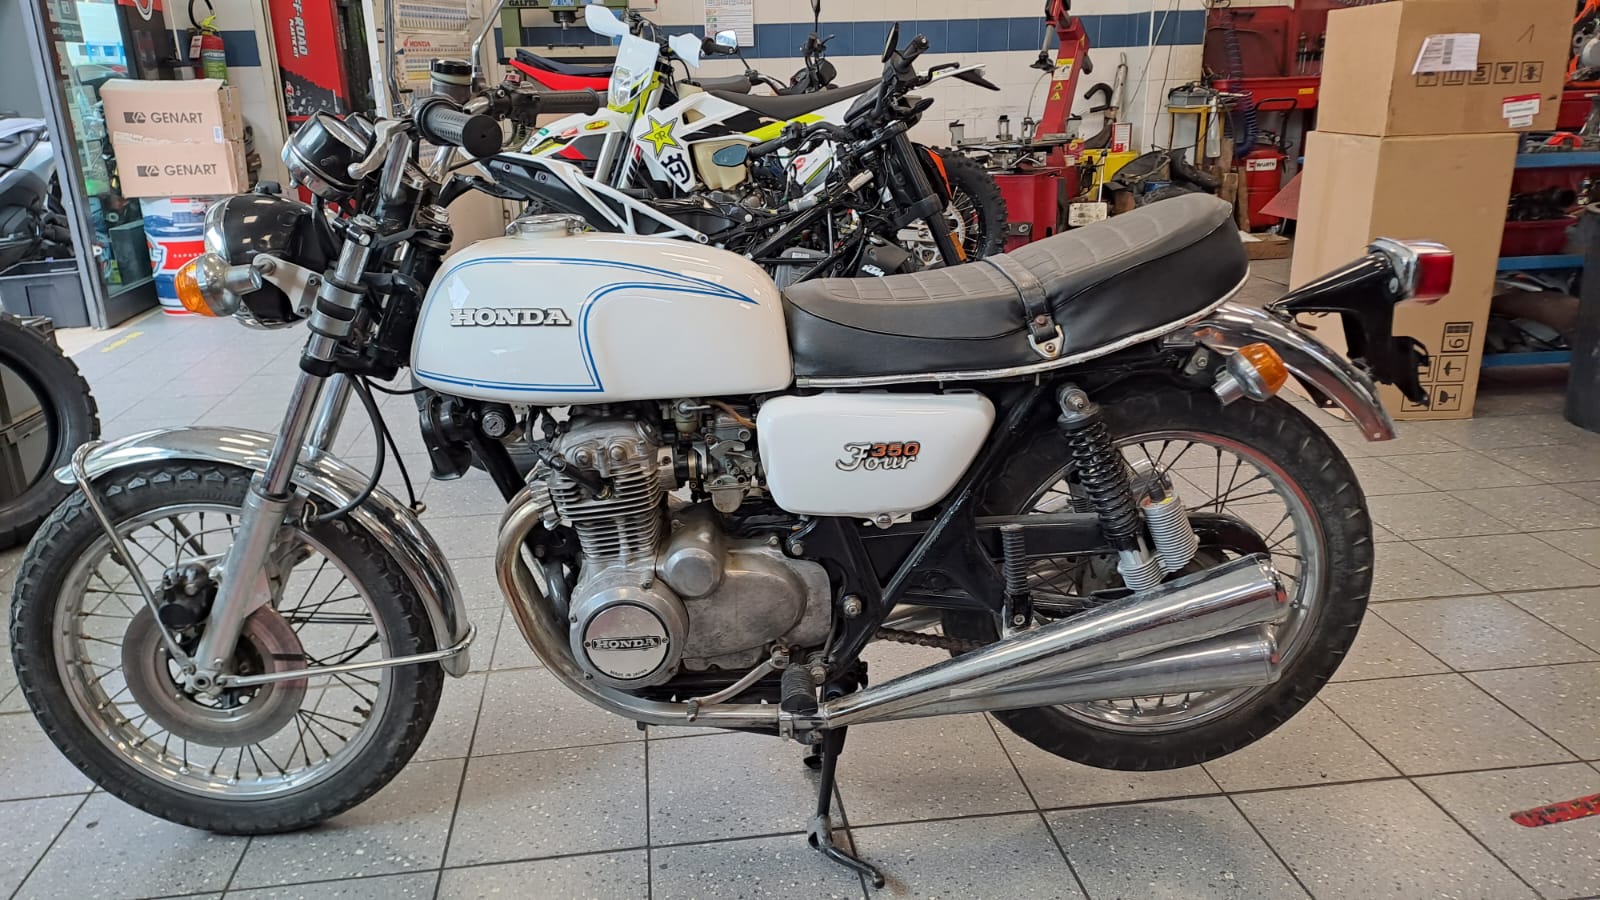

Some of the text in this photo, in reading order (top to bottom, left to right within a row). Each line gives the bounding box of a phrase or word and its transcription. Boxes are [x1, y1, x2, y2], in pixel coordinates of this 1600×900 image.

[150, 112, 203, 124] GENART
[164, 164, 217, 176] GENART
[450, 307, 571, 327] HONDA
[870, 441, 920, 457] 350
[835, 442, 916, 472] Four
[594, 637, 658, 649] HONDA
